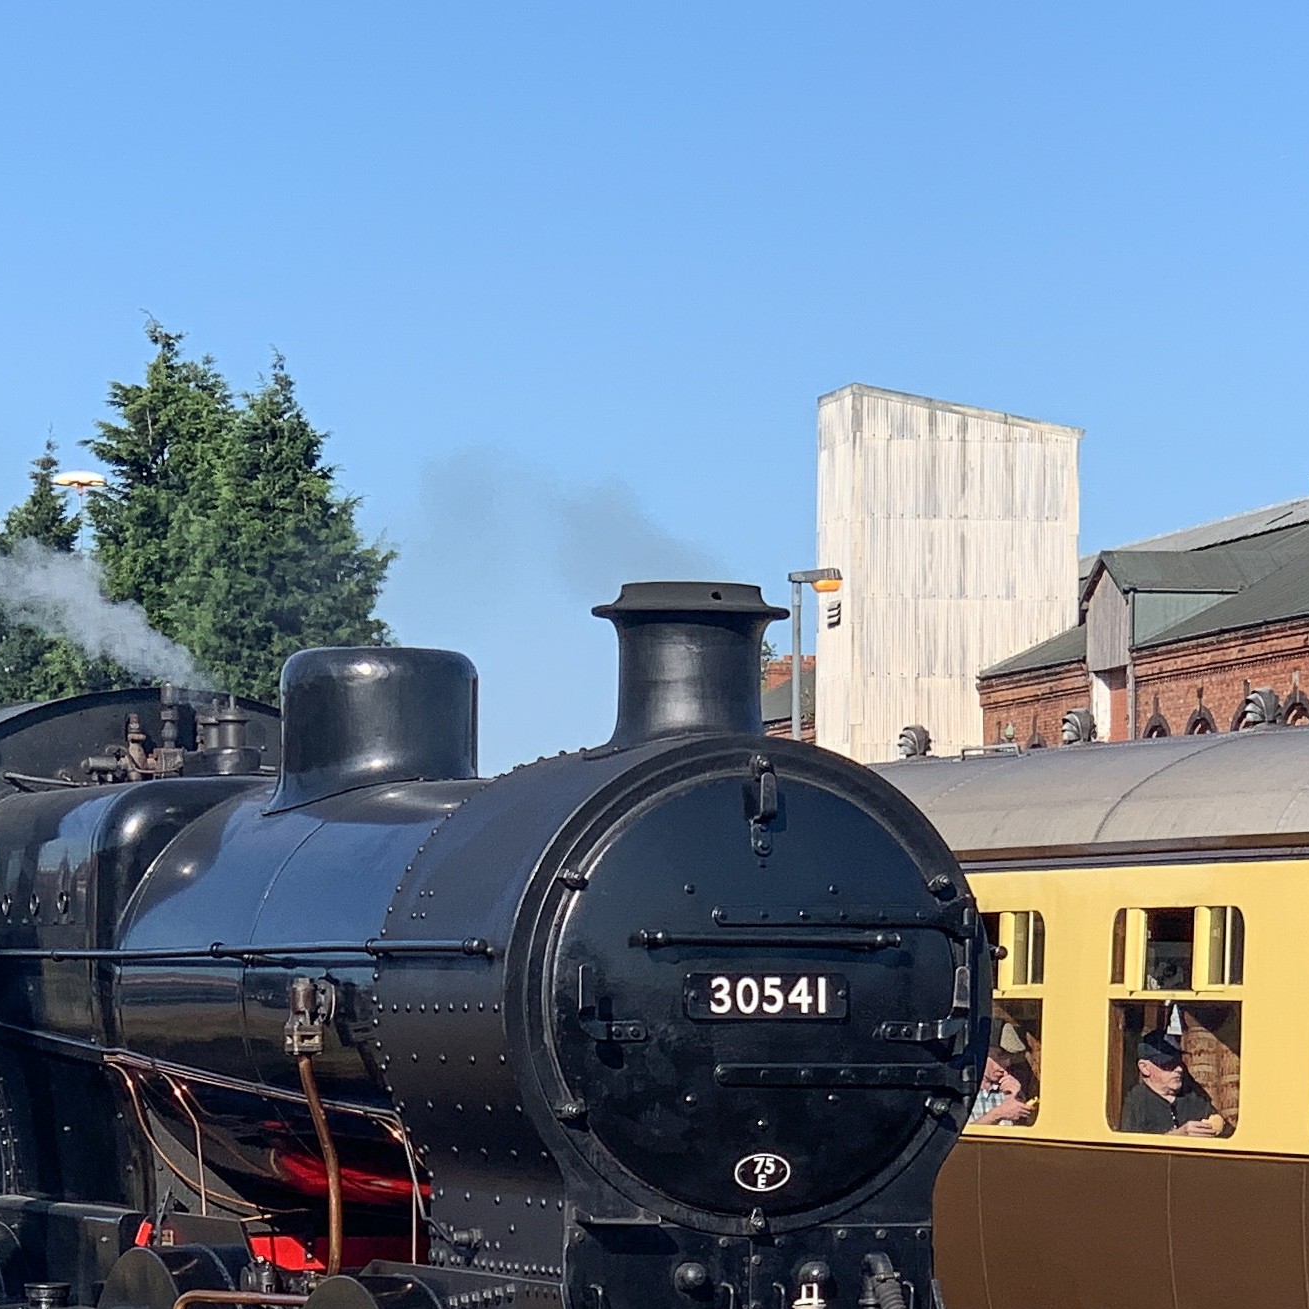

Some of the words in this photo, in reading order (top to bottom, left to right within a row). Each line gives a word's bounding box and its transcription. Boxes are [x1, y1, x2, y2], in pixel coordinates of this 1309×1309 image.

[709, 976, 827, 1015] 30541
[753, 1157, 776, 1175] 75
[757, 1175, 767, 1189] E
